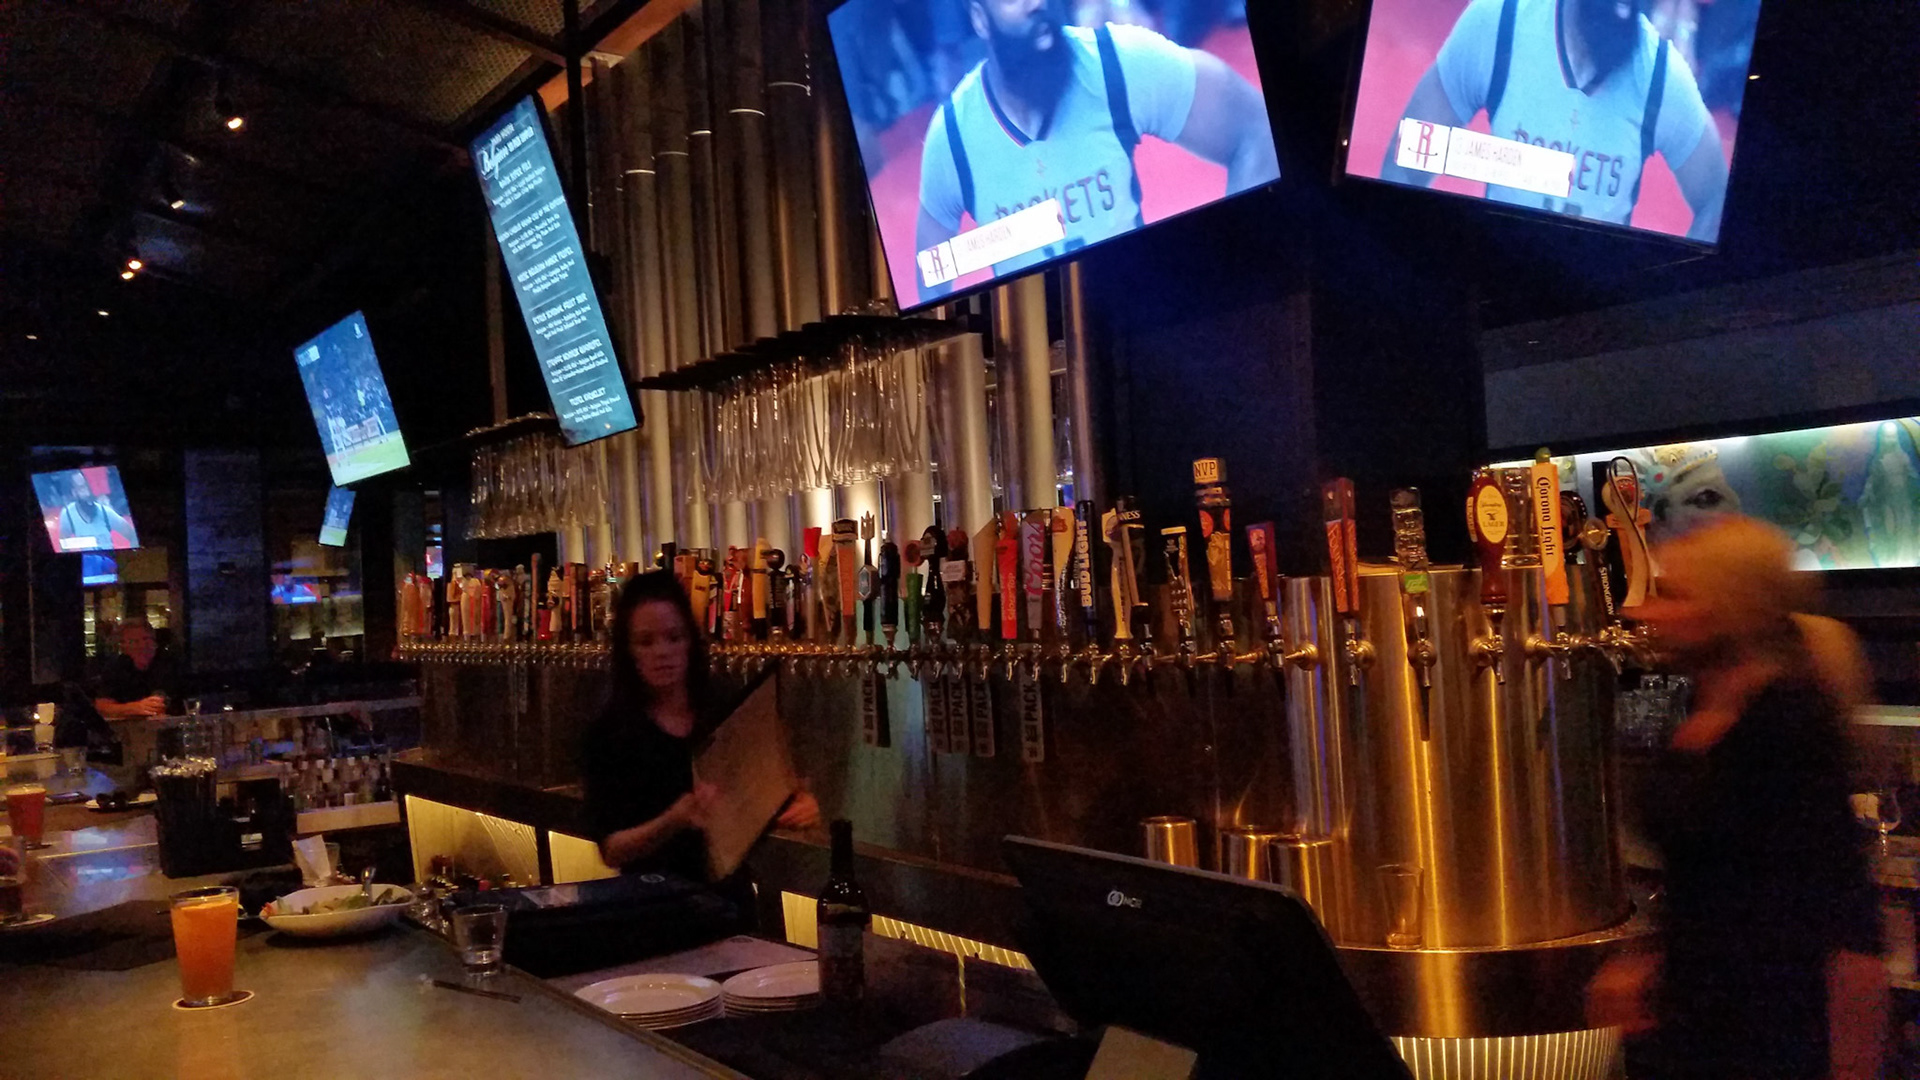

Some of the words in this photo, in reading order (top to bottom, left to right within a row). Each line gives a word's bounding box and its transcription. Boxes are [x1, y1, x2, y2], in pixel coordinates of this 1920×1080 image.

[1194, 462, 1216, 478] NVP
[1537, 476, 1552, 522] Corona
[1024, 522, 1044, 596] Coors
[1076, 518, 1090, 568] LIGHT
[1541, 526, 1556, 555] Light
[1079, 570, 1092, 607] BUD
[1598, 566, 1615, 615] STRONGBOW
